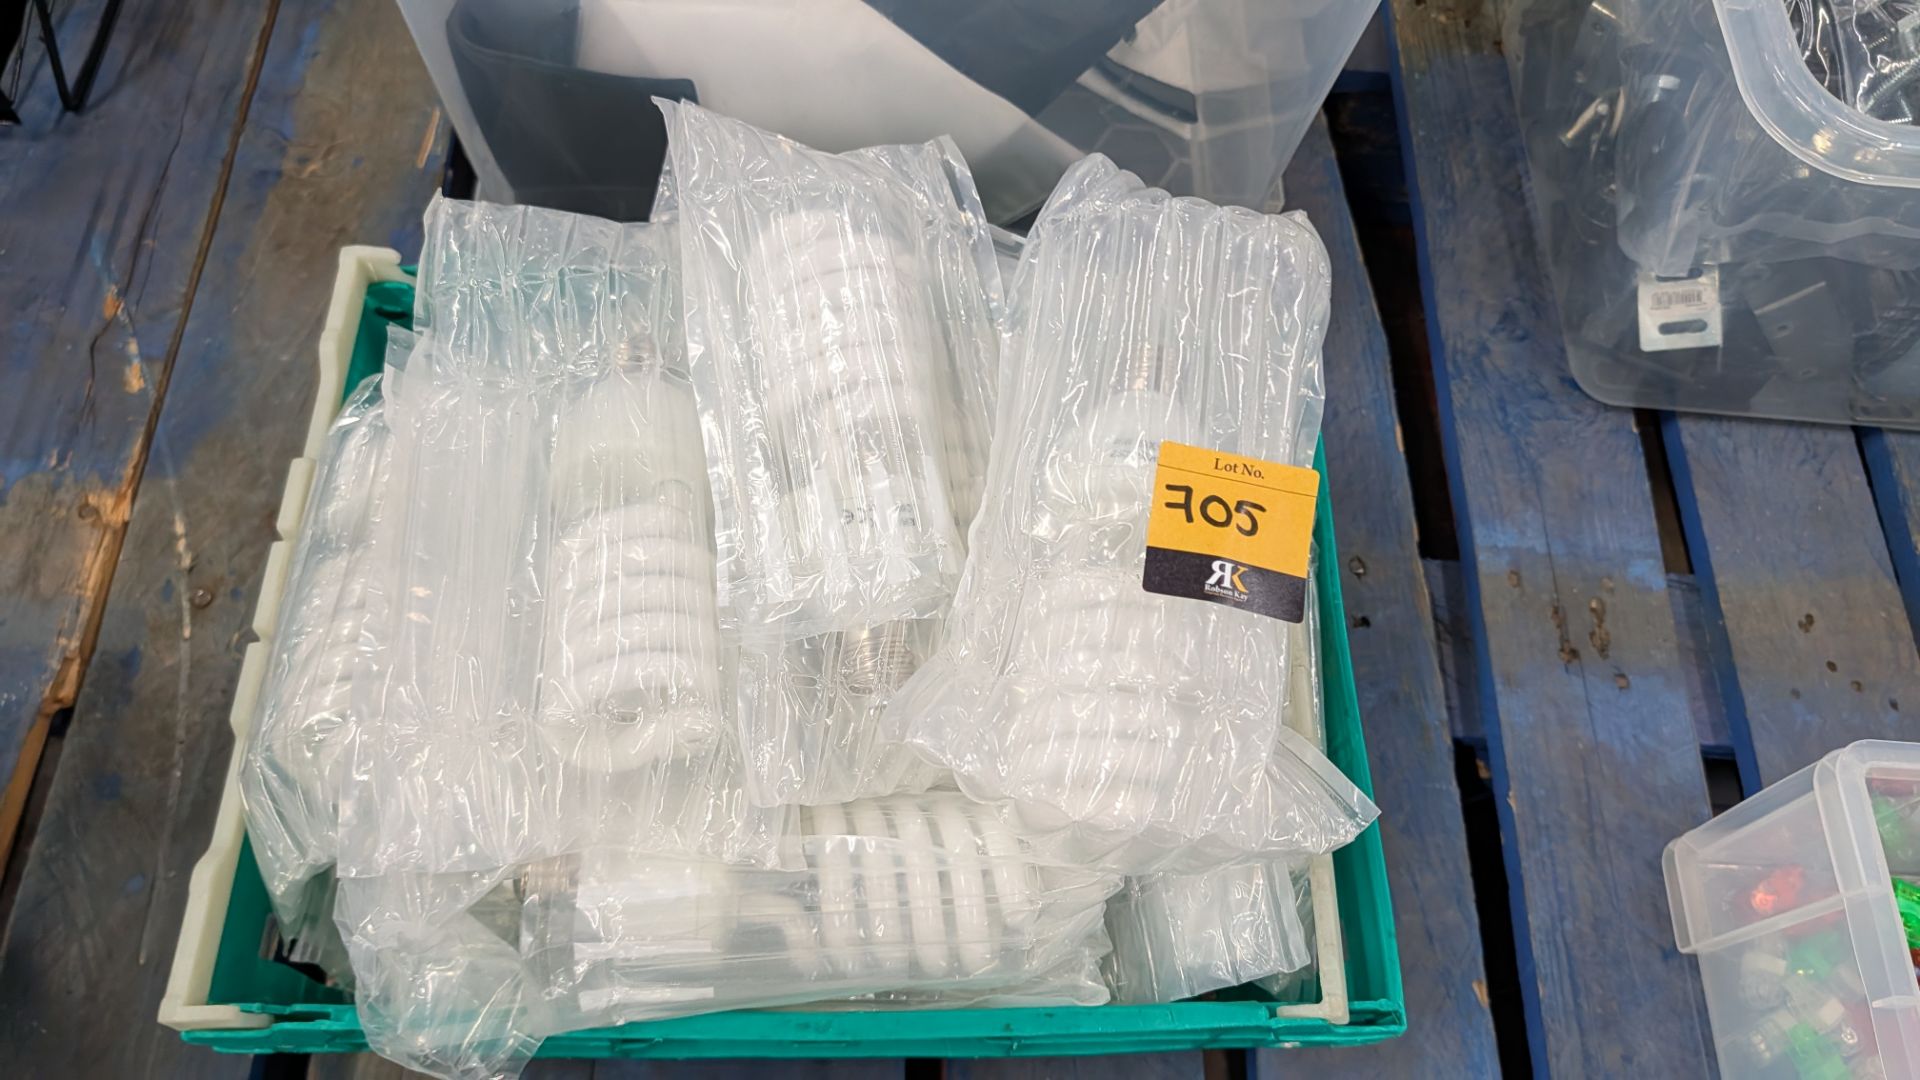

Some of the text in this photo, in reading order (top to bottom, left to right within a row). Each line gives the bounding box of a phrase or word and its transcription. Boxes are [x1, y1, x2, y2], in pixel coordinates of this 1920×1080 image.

[1214, 457, 1265, 480] Lot No.
[1165, 484, 1267, 537] 705
